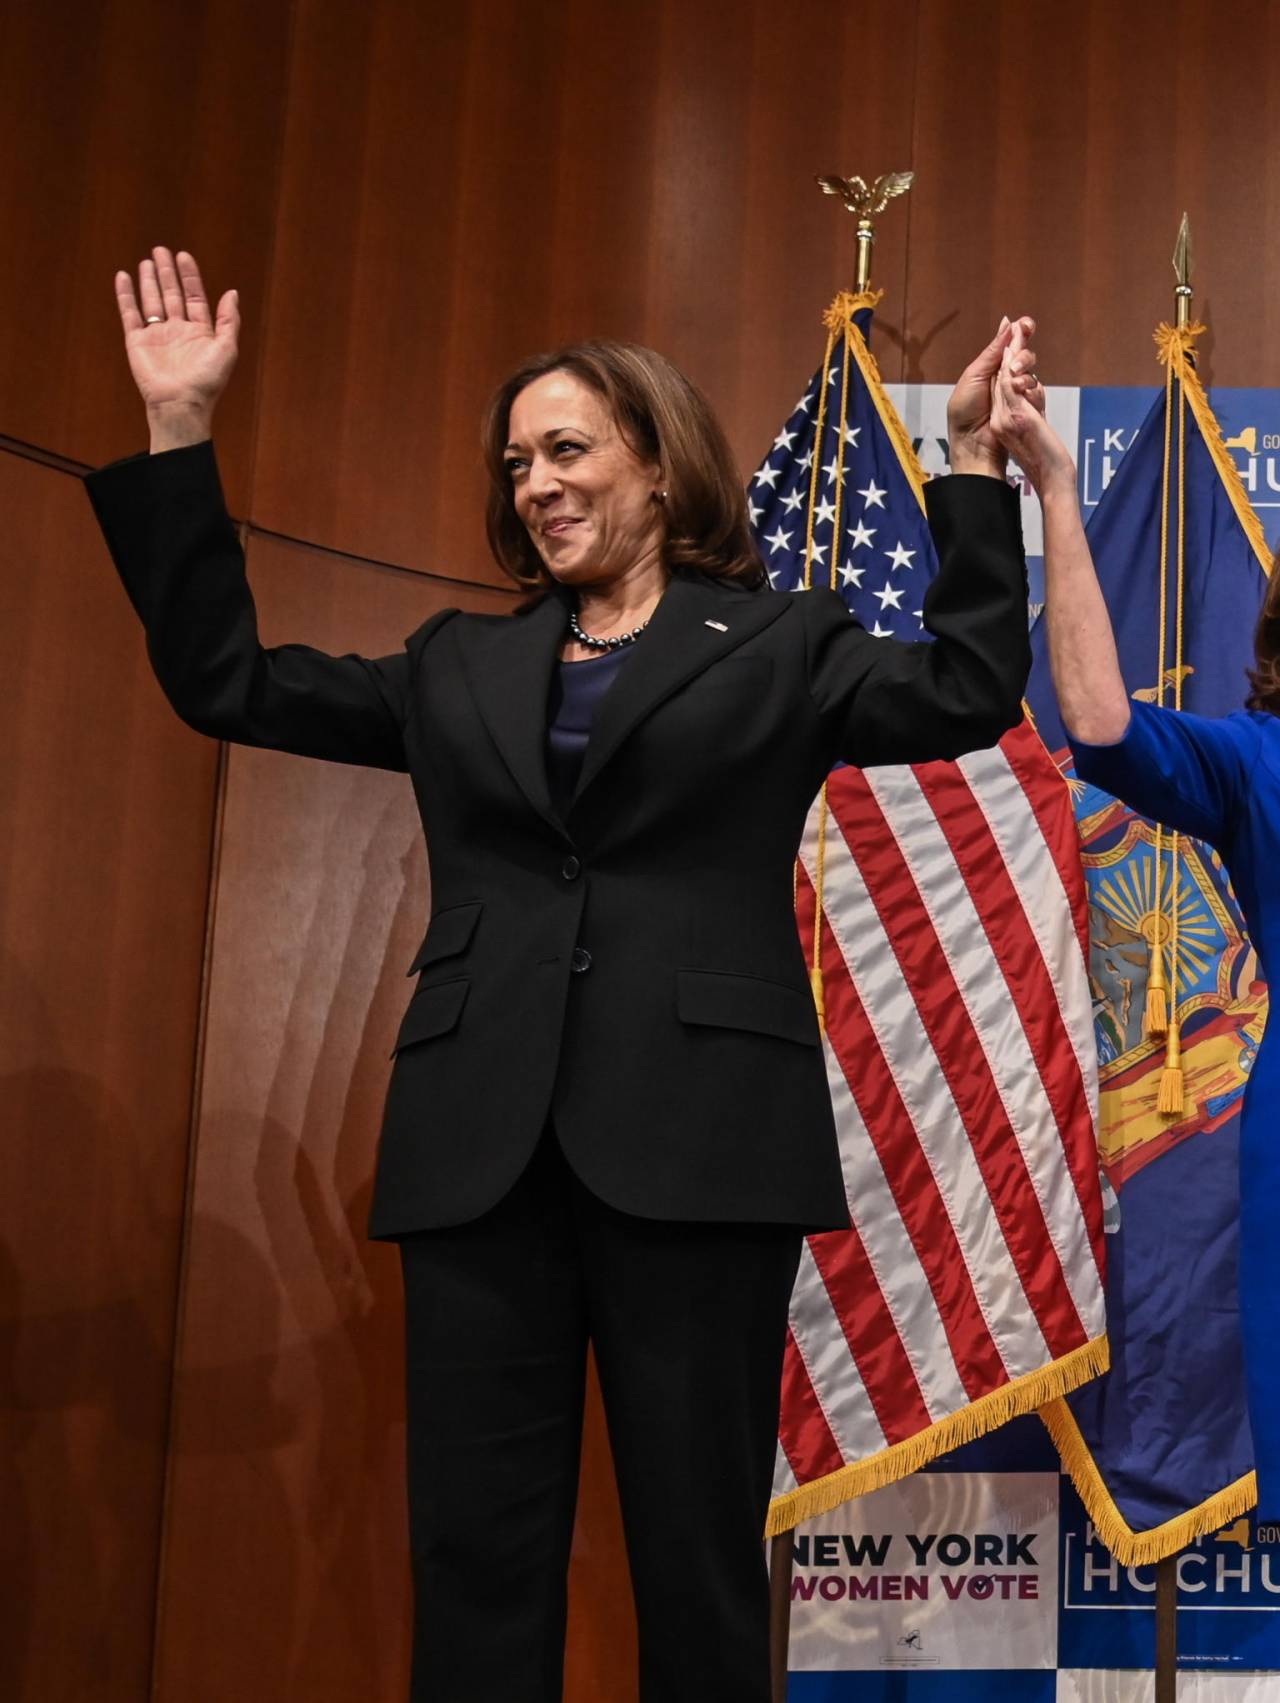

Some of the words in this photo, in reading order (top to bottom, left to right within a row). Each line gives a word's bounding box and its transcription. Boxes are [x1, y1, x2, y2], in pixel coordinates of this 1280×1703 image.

[905, 1534, 1039, 1566] YORK
[790, 1575, 929, 1601] WOMEN
[940, 1574, 1039, 1601] VOTE
